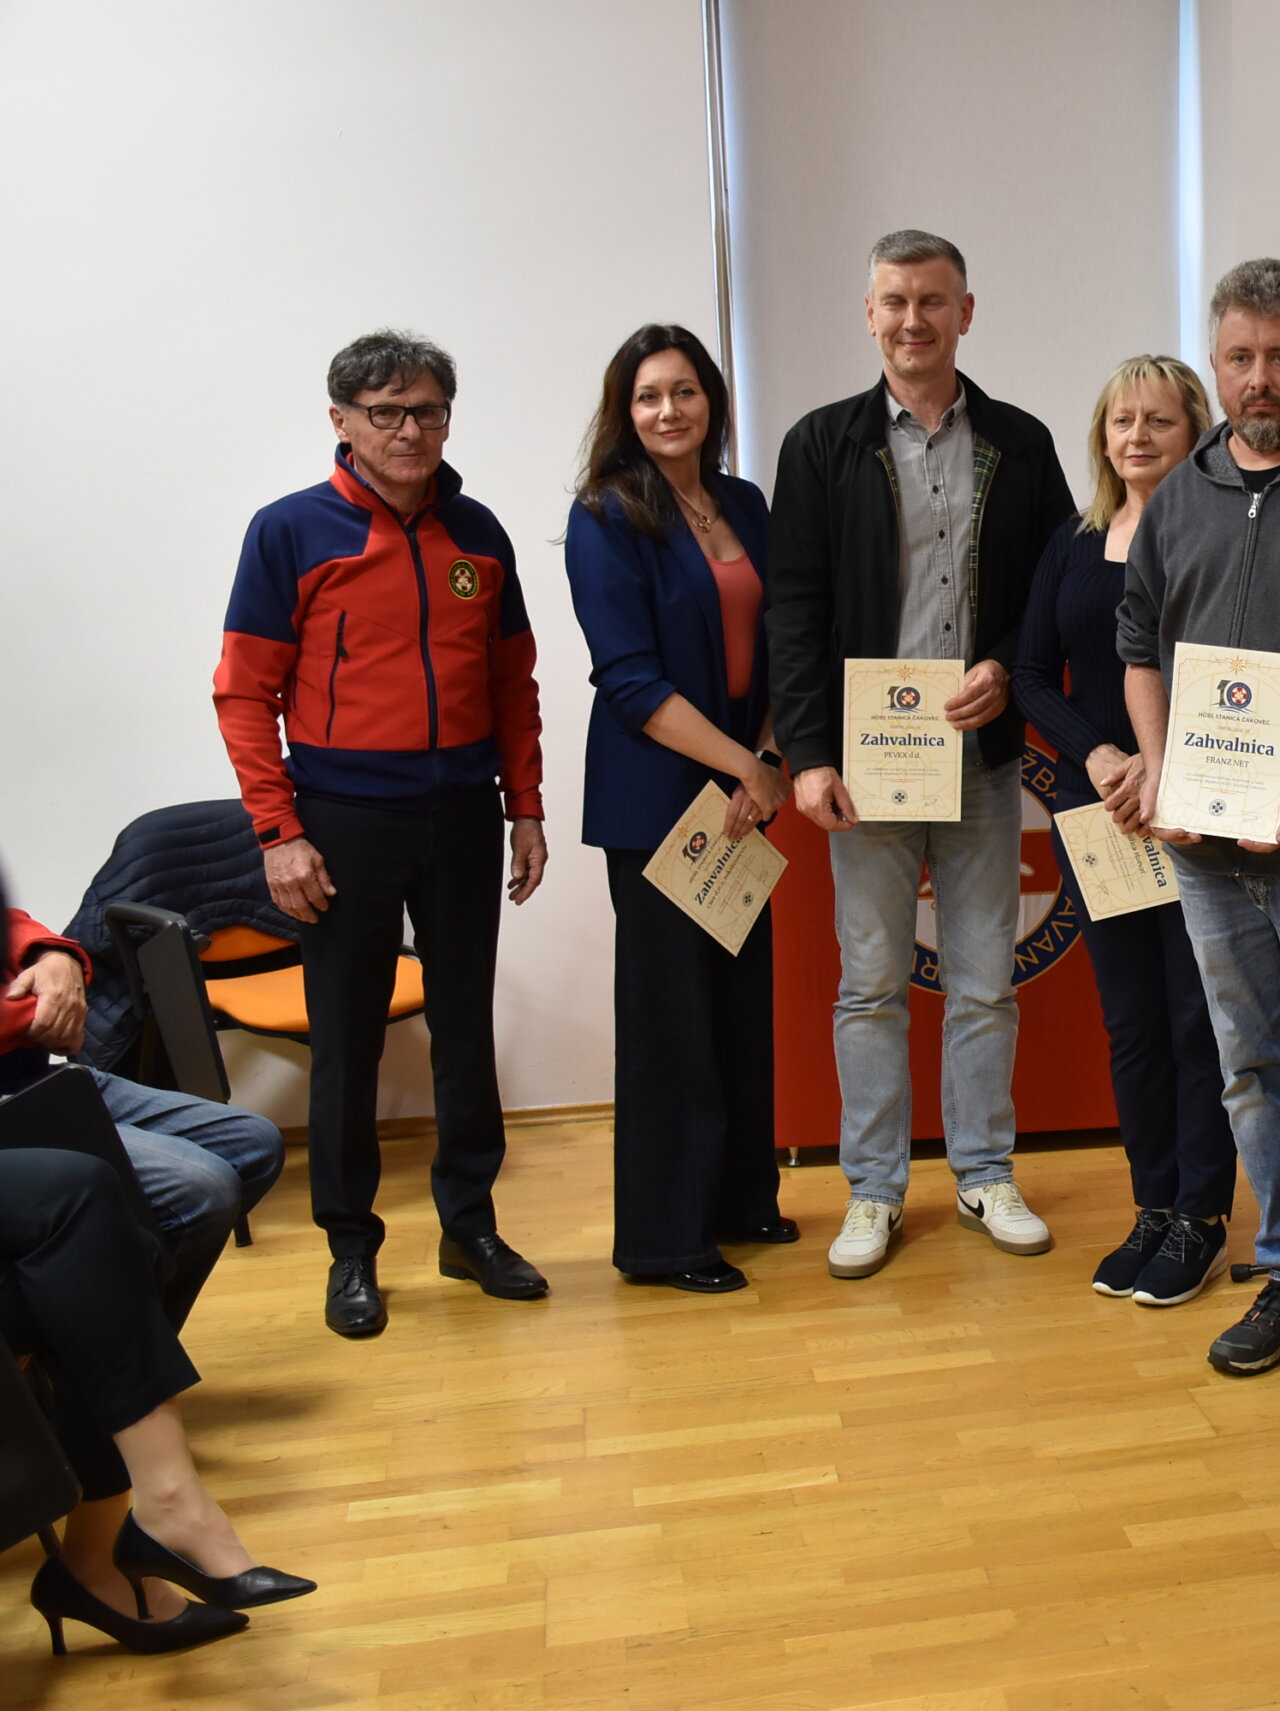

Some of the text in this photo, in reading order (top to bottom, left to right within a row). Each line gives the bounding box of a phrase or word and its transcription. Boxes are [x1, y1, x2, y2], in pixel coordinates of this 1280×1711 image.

[1215, 714, 1241, 722] STANICA
[860, 732, 945, 747] Zahvalnica
[1184, 731, 1275, 757] Zahvalnica
[884, 751, 907, 759] PEVEX
[1205, 755, 1250, 768] FRANZ NET
[1142, 835, 1167, 888] valnica
